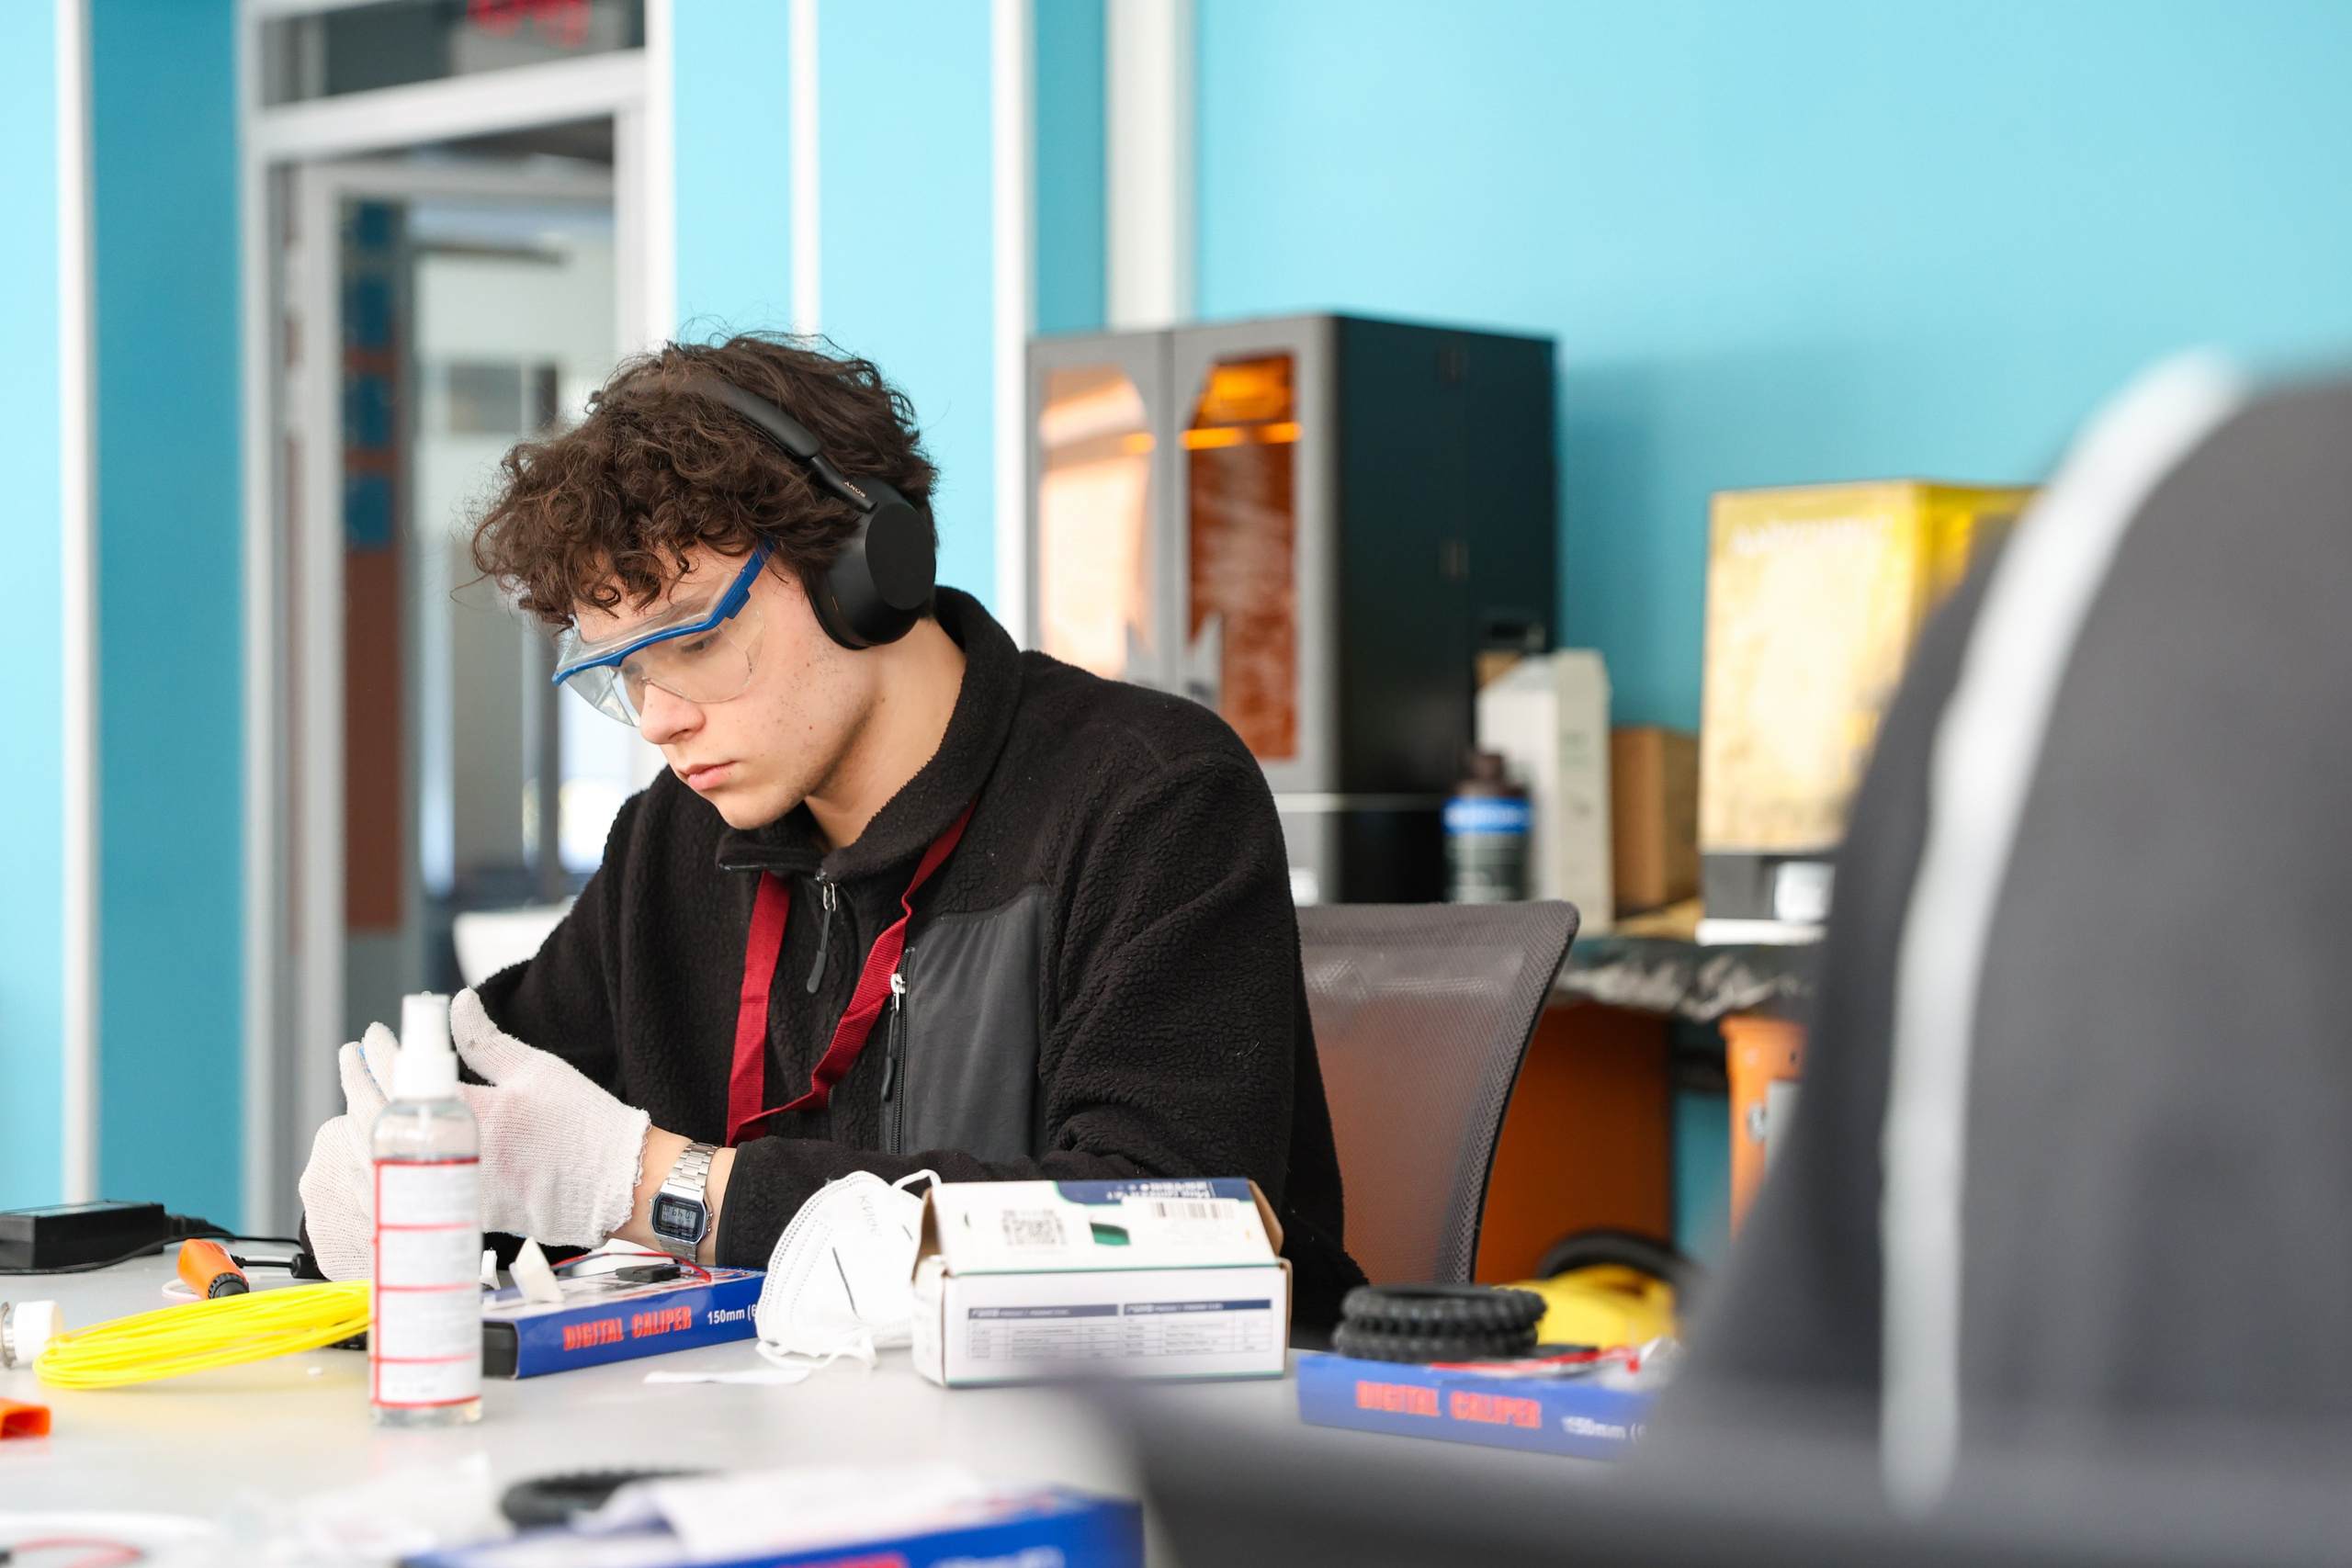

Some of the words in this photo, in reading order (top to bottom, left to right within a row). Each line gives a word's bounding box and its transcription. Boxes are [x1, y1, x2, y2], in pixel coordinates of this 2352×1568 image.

[844, 481, 866, 497] SONY
[563, 1317, 624, 1351] DIGITAL
[632, 1305, 693, 1338] CALIPER
[707, 1309, 745, 1325] 150mm
[1355, 1381, 1441, 1417] DIGITAL
[1449, 1391, 1542, 1429] CALIPER
